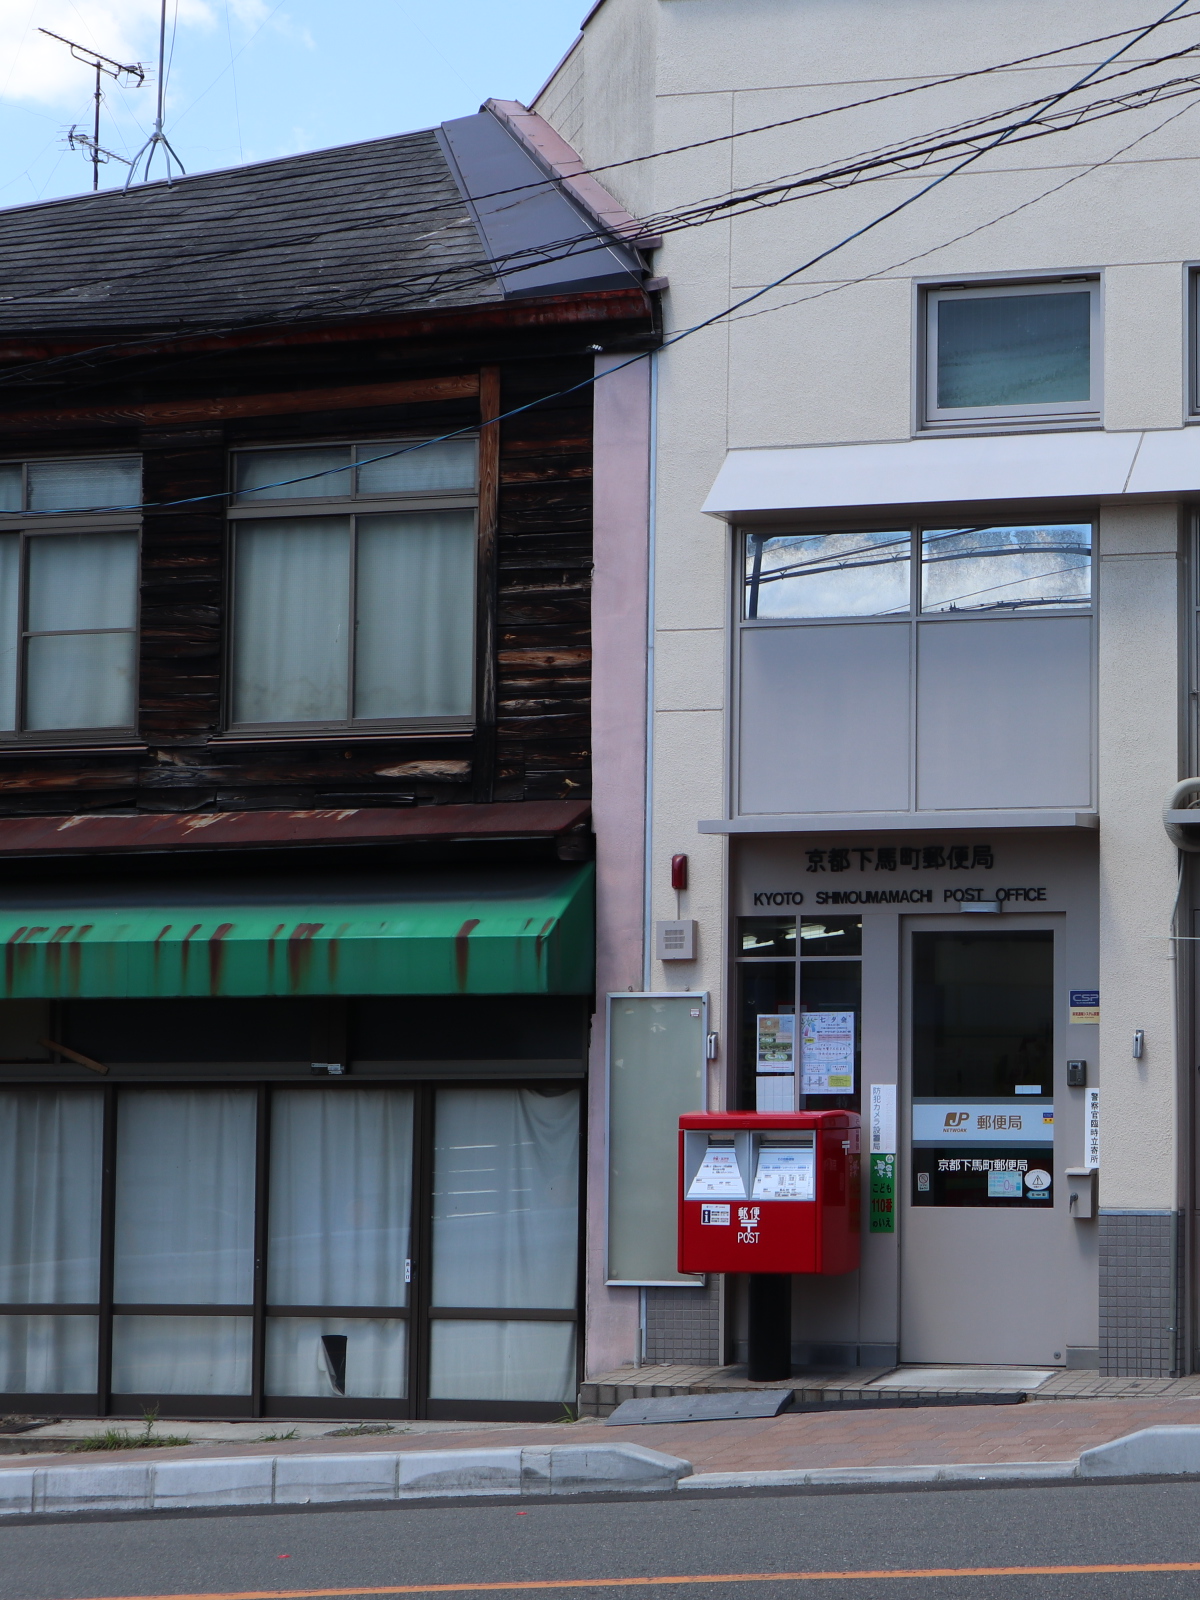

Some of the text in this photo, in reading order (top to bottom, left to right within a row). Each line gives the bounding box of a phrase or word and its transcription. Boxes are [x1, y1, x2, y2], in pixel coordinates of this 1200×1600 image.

[804, 844, 994, 873] 京都下馬町郵便局
[753, 887, 1047, 906] KYOTO SHIMOUMAMACHI POST OFFICE
[1072, 994, 1099, 1002] CSP
[872, 1087, 881, 1151] 防犯カメラ設置局
[944, 1112, 1022, 1130] JP 郵便局
[938, 1159, 1028, 1172] 京都下馬町郵便局
[872, 1183, 892, 1194] こども
[872, 1198, 892, 1213] 110番
[738, 1207, 760, 1220] 郵便
[872, 1218, 892, 1228] のいえ
[737, 1232, 760, 1243] POST
